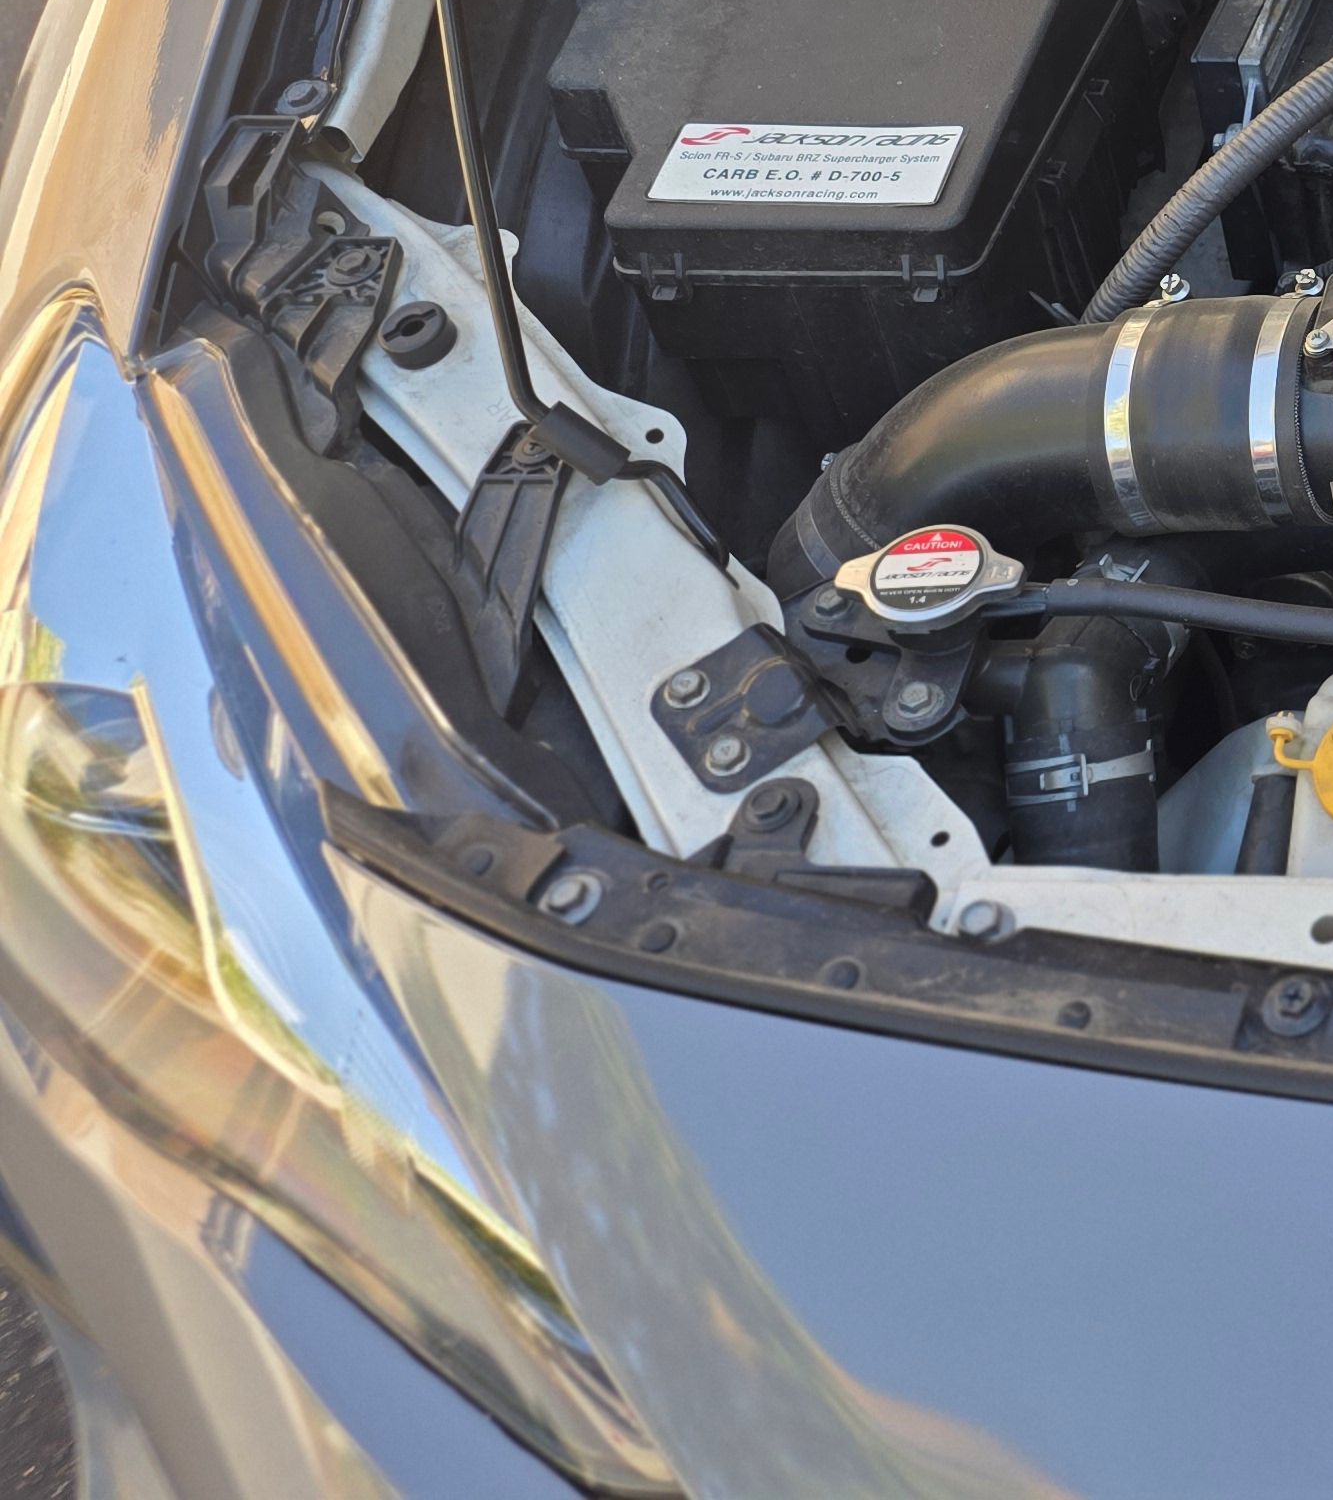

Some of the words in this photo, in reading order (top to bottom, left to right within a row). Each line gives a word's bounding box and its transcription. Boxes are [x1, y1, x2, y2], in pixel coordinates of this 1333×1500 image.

[679, 150, 712, 161] Scion
[714, 151, 743, 161] FR-S
[753, 152, 793, 163] Subaru
[796, 153, 821, 163] BRZ
[822, 153, 897, 165] Supercharger
[899, 153, 940, 165] System
[702, 168, 759, 180] CARB
[764, 169, 803, 181] E.O.
[810, 169, 822, 181] #
[827, 170, 902, 182] D-700-5
[709, 187, 878, 200] www.jacksonracing.com
[903, 540, 963, 551] CAUTION!
[909, 595, 927, 604] 1.4
